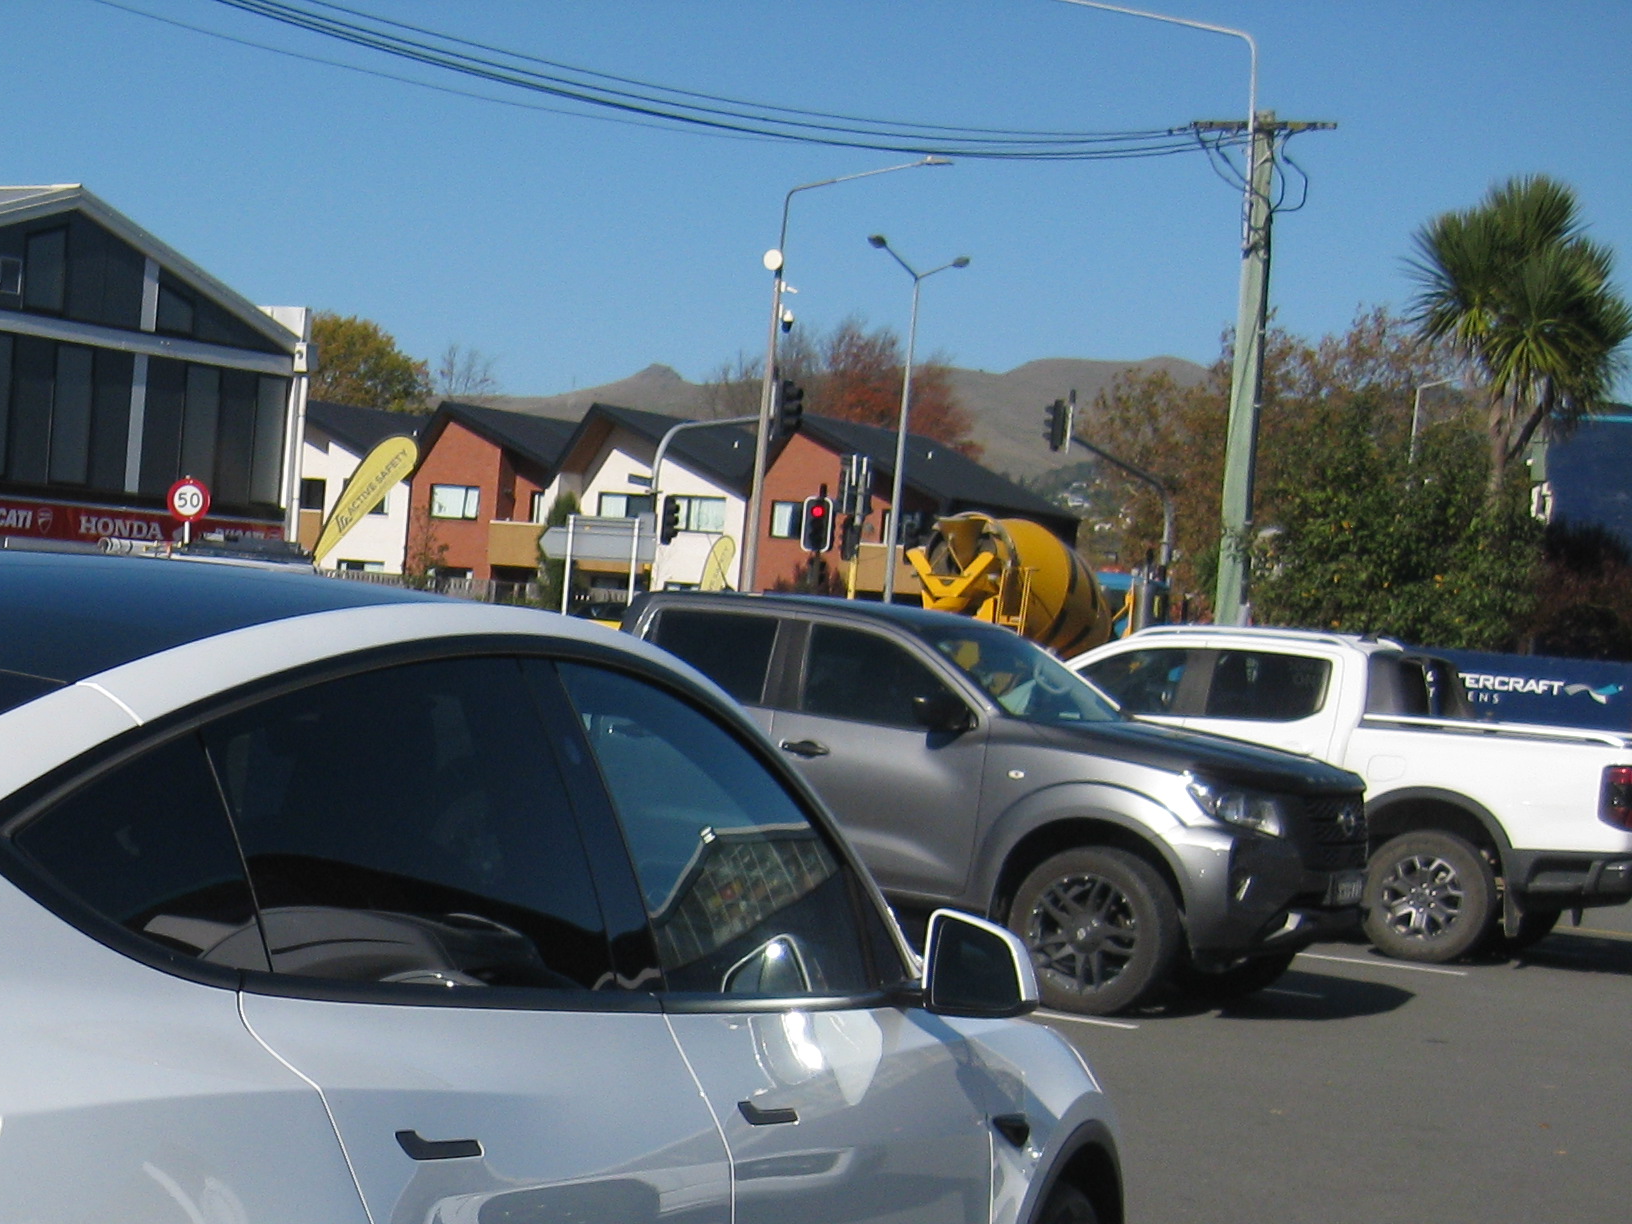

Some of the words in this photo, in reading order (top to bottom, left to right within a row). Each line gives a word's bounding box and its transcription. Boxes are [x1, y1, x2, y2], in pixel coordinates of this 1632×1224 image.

[348, 481, 378, 516] ACTIVE
[375, 448, 408, 484] SAFETY
[177, 492, 201, 509] 50
[78, 515, 165, 541] HONDA
